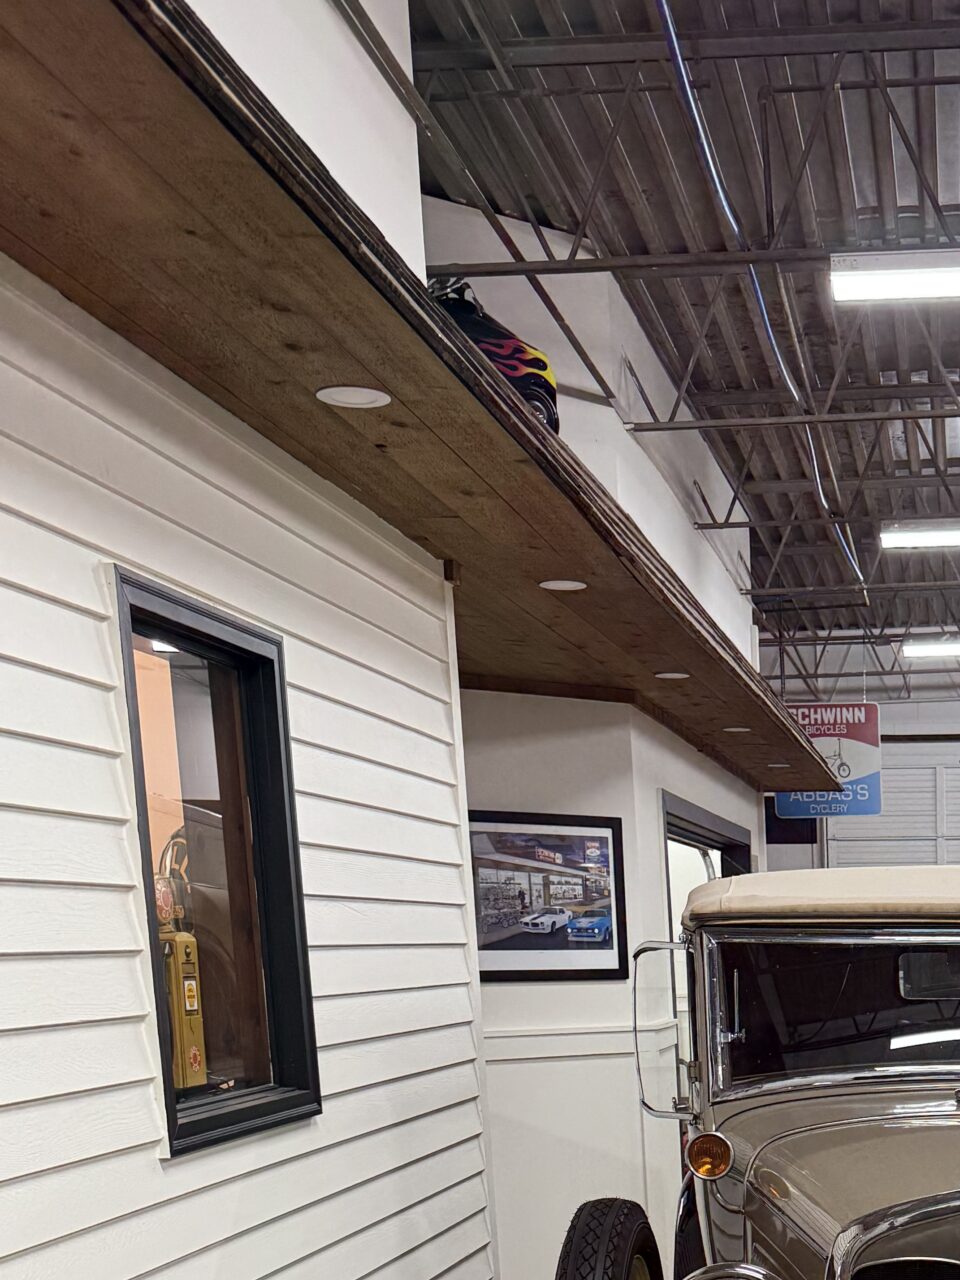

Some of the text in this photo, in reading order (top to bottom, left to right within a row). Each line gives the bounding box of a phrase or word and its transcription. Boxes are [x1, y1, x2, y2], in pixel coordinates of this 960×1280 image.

[805, 725, 847, 735] BICYCLES
[790, 784, 869, 802] ABBAS'S
[809, 803, 849, 814] CYCLERY
